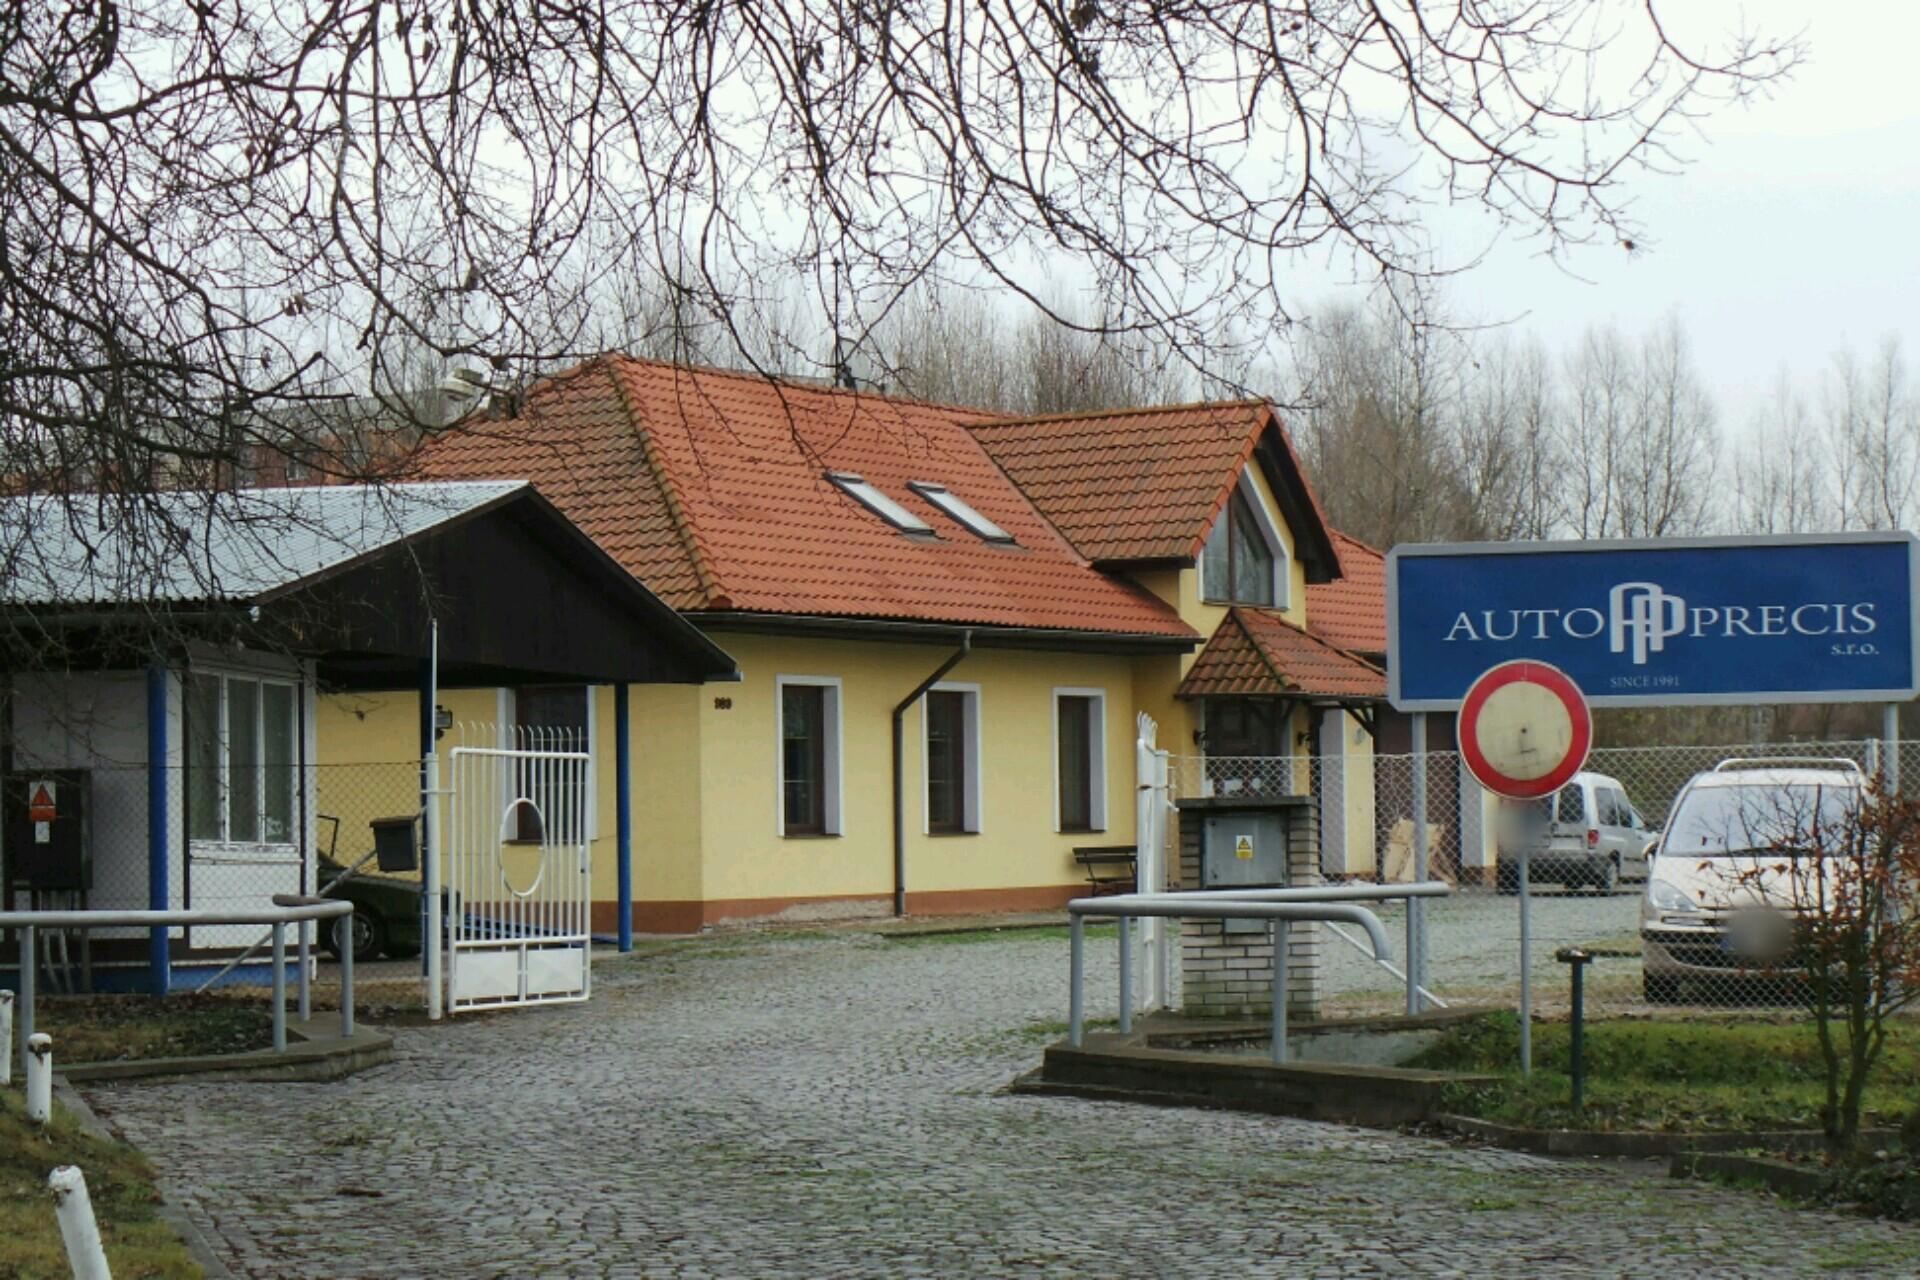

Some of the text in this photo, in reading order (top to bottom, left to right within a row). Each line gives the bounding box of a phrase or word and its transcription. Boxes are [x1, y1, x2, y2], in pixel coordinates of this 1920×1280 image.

[1442, 608, 1605, 641] AUTO
[1688, 602, 1877, 637] PRECIS
[1609, 674, 1681, 689] SINCE 1991
